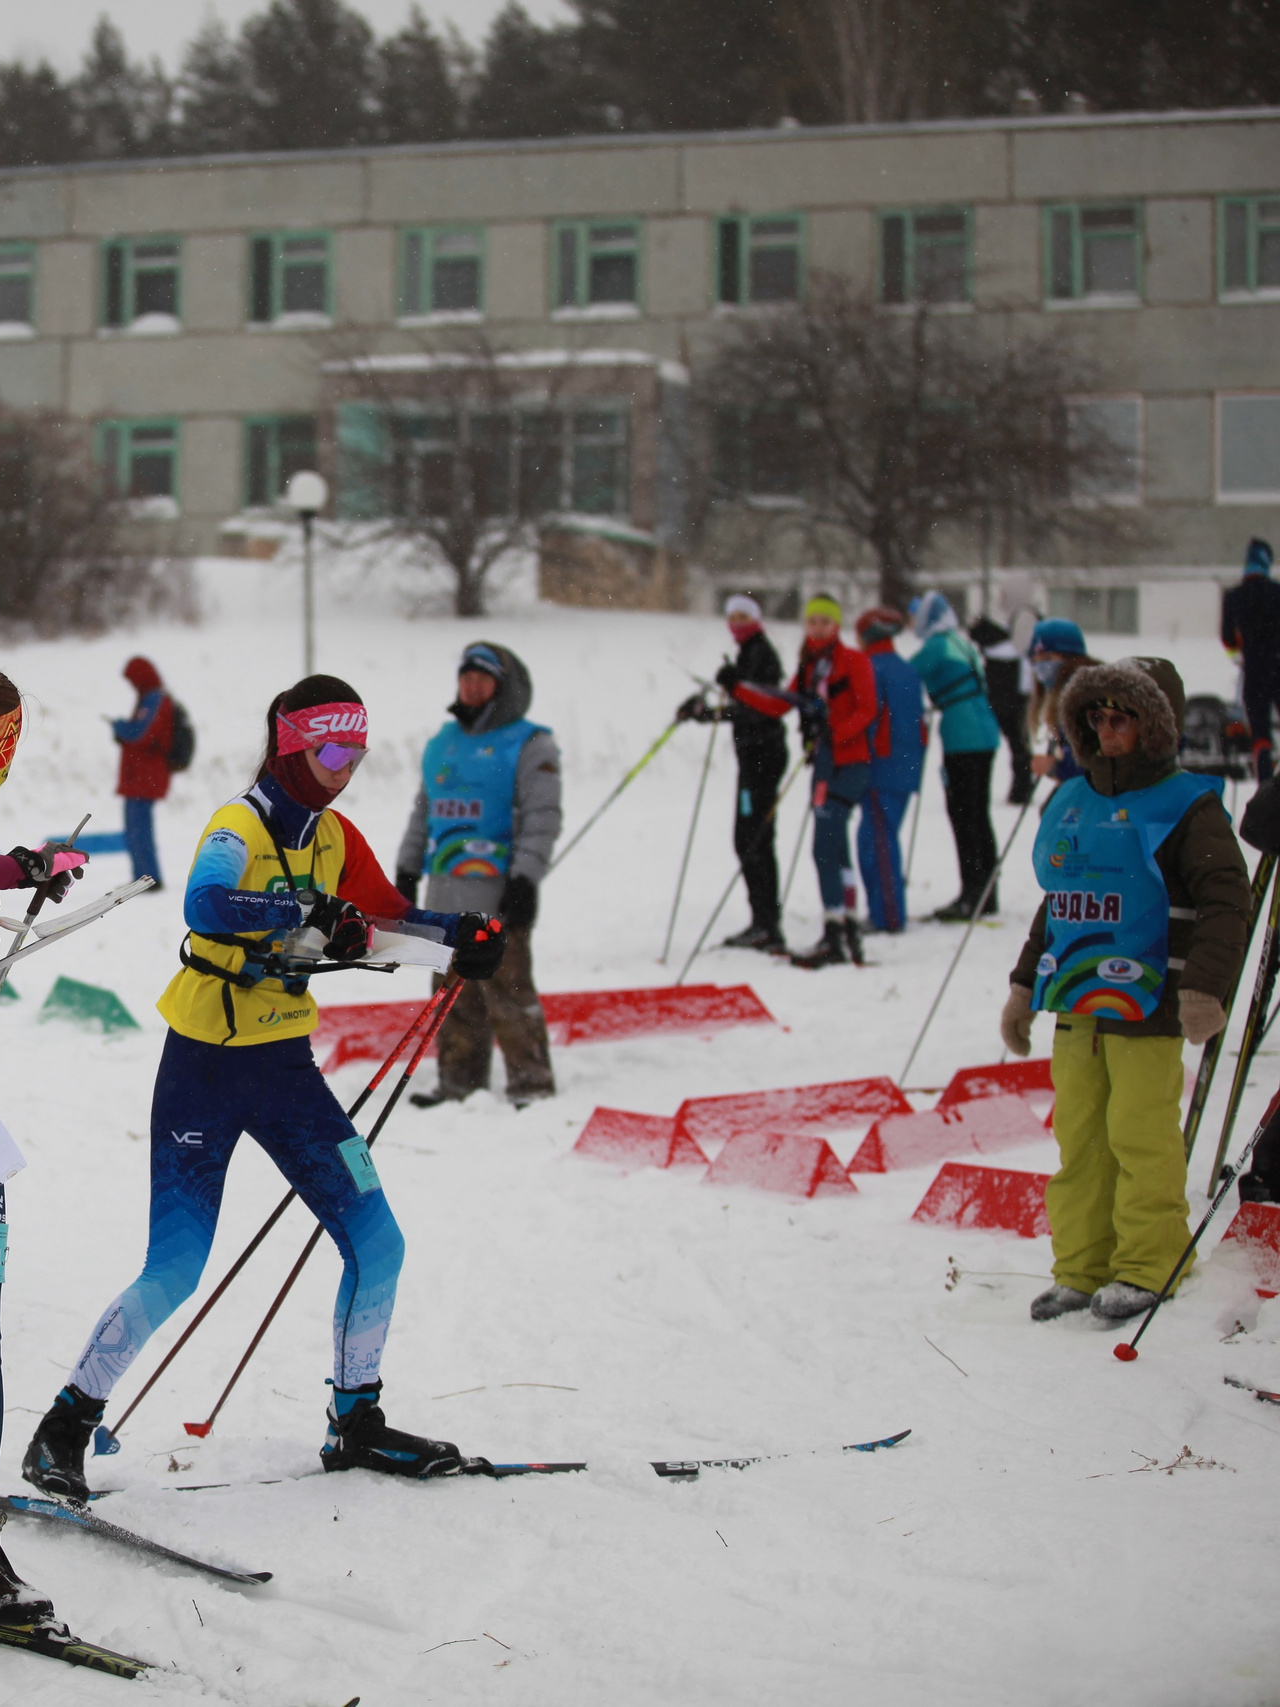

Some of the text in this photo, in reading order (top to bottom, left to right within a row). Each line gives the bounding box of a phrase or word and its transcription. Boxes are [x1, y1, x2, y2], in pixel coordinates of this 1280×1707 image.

[228, 895, 271, 904] VICTORY
[1048, 891, 1122, 923] СУДЬЯ
[96, 1306, 124, 1342] VICTORY
